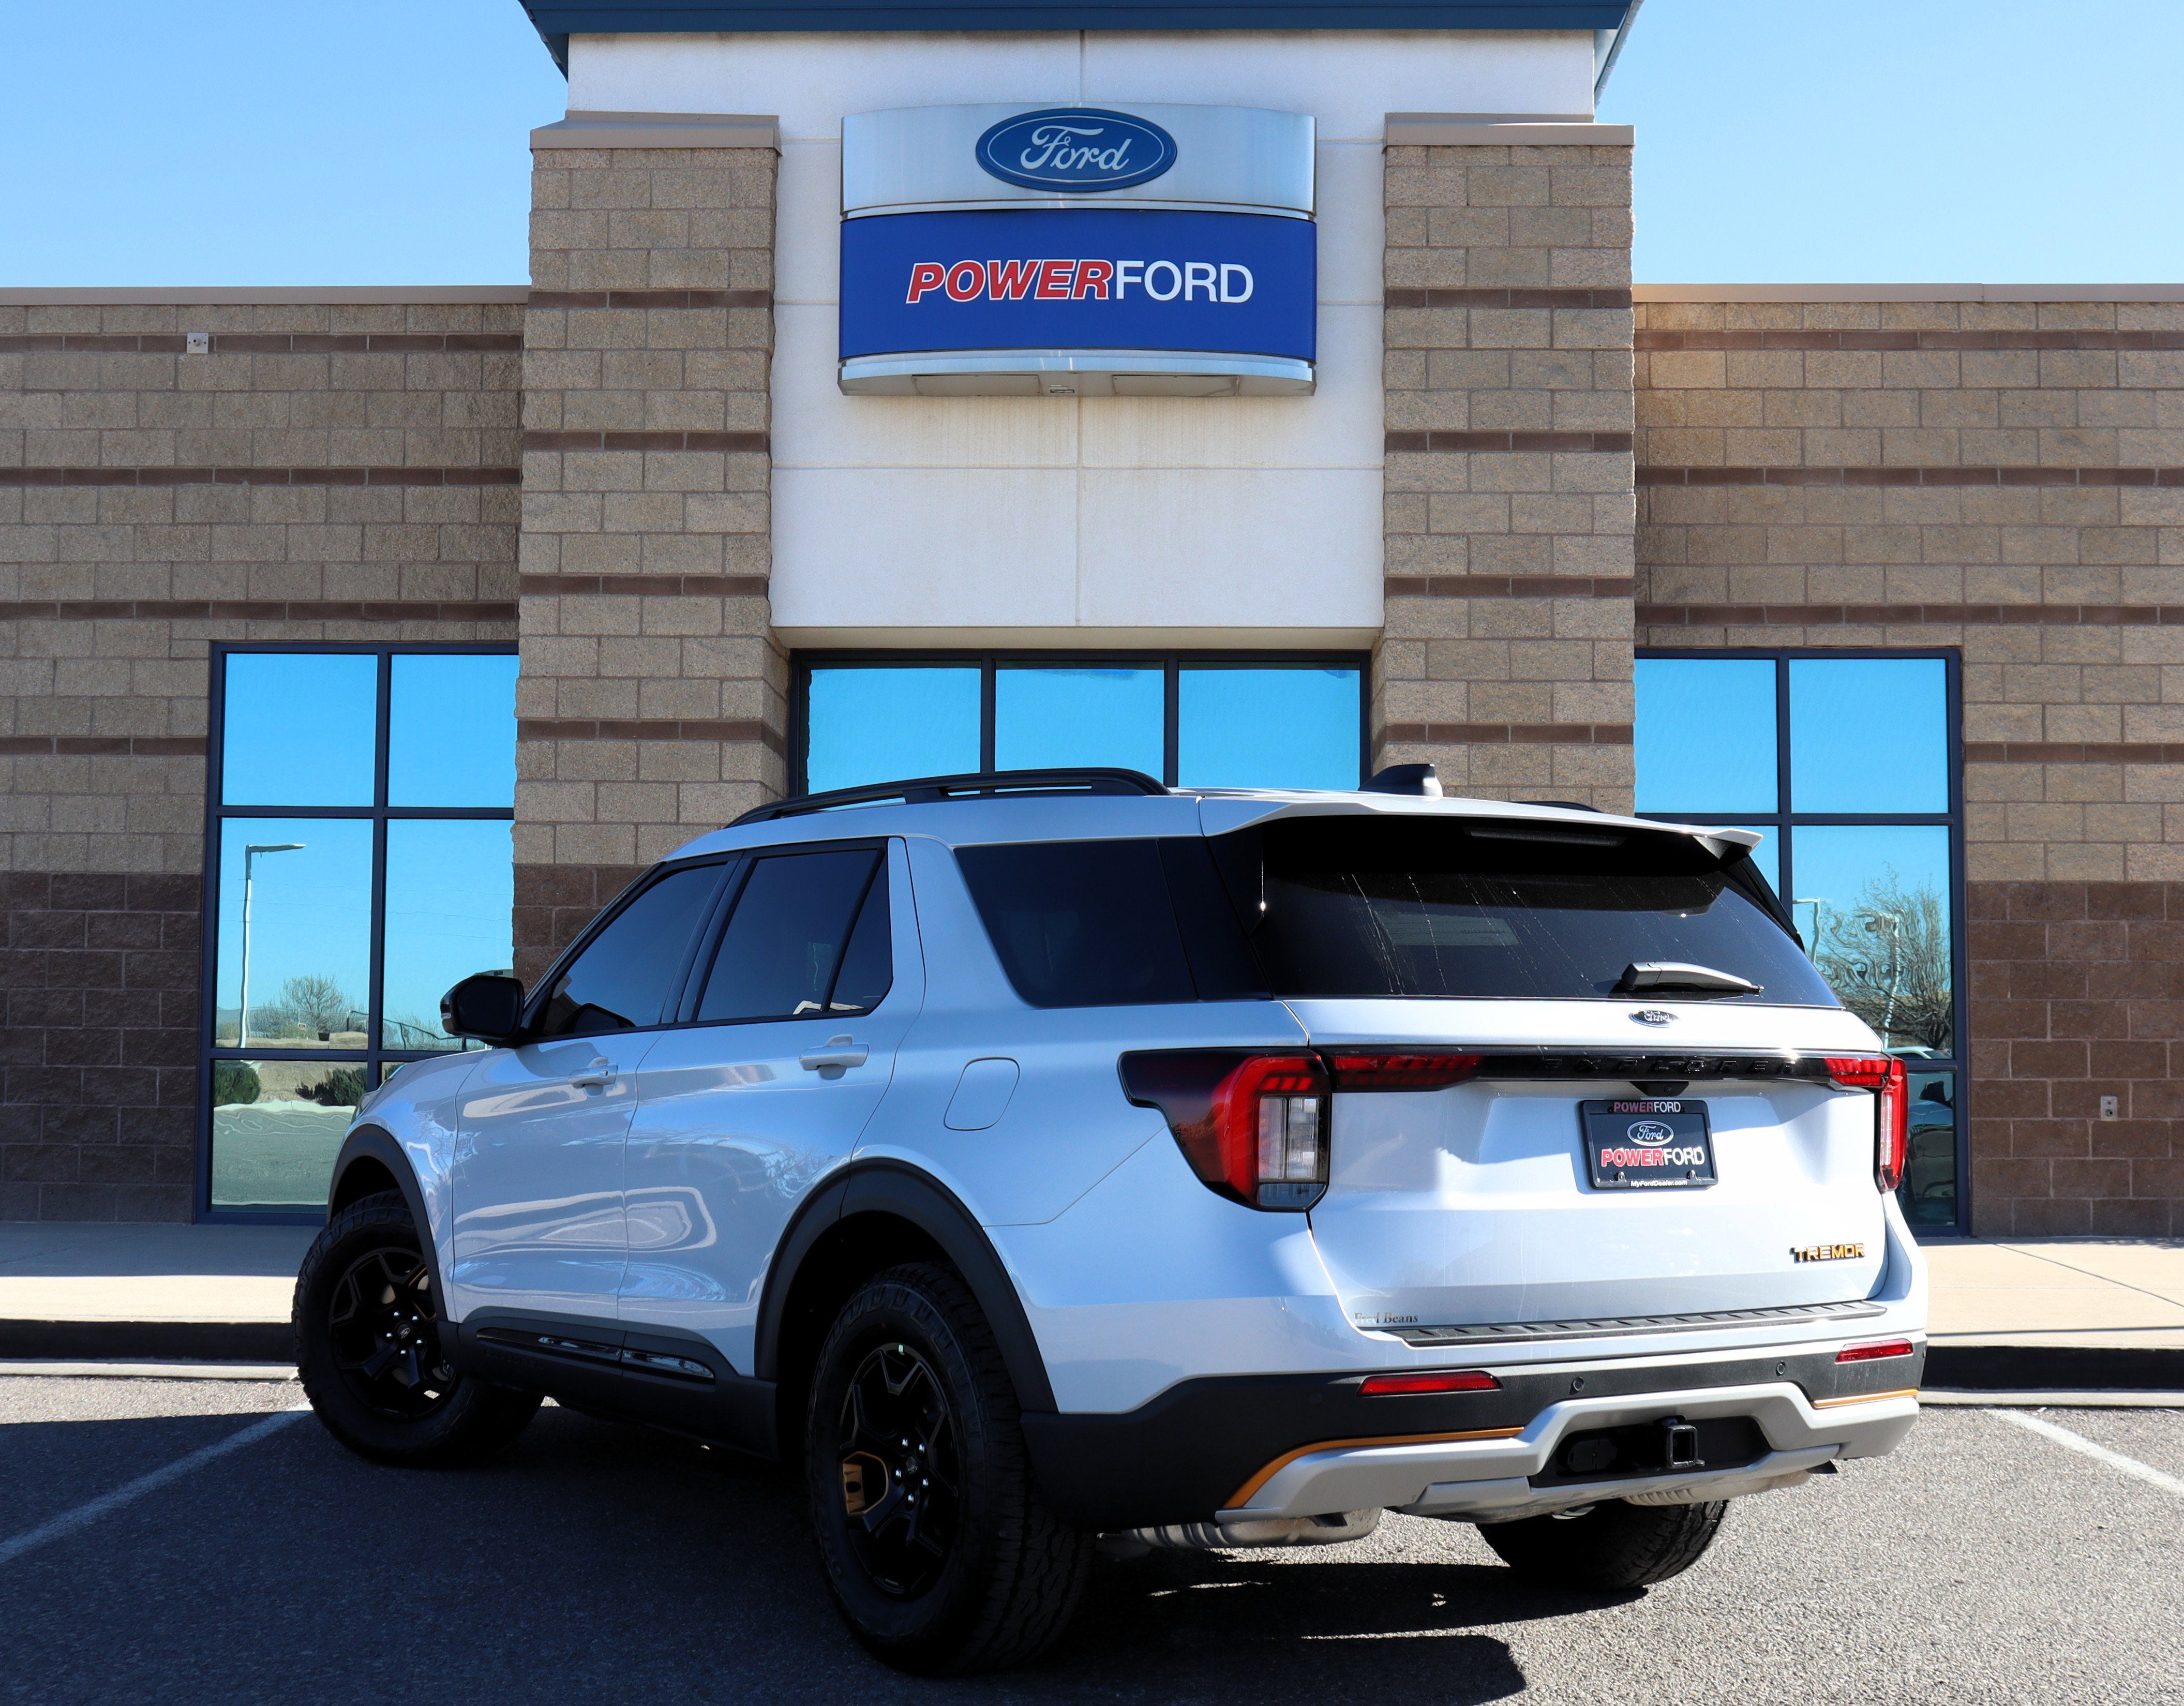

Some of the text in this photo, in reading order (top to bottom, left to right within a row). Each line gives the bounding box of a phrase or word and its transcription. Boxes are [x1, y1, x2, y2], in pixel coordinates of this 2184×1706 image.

[1020, 125, 1132, 172] Ford
[1644, 1010, 1672, 1022] Ford
[1637, 1125, 1664, 1140] Ford
[1789, 1243, 1865, 1263] TREMOR
[1354, 1312, 1418, 1324] Fred Beans
